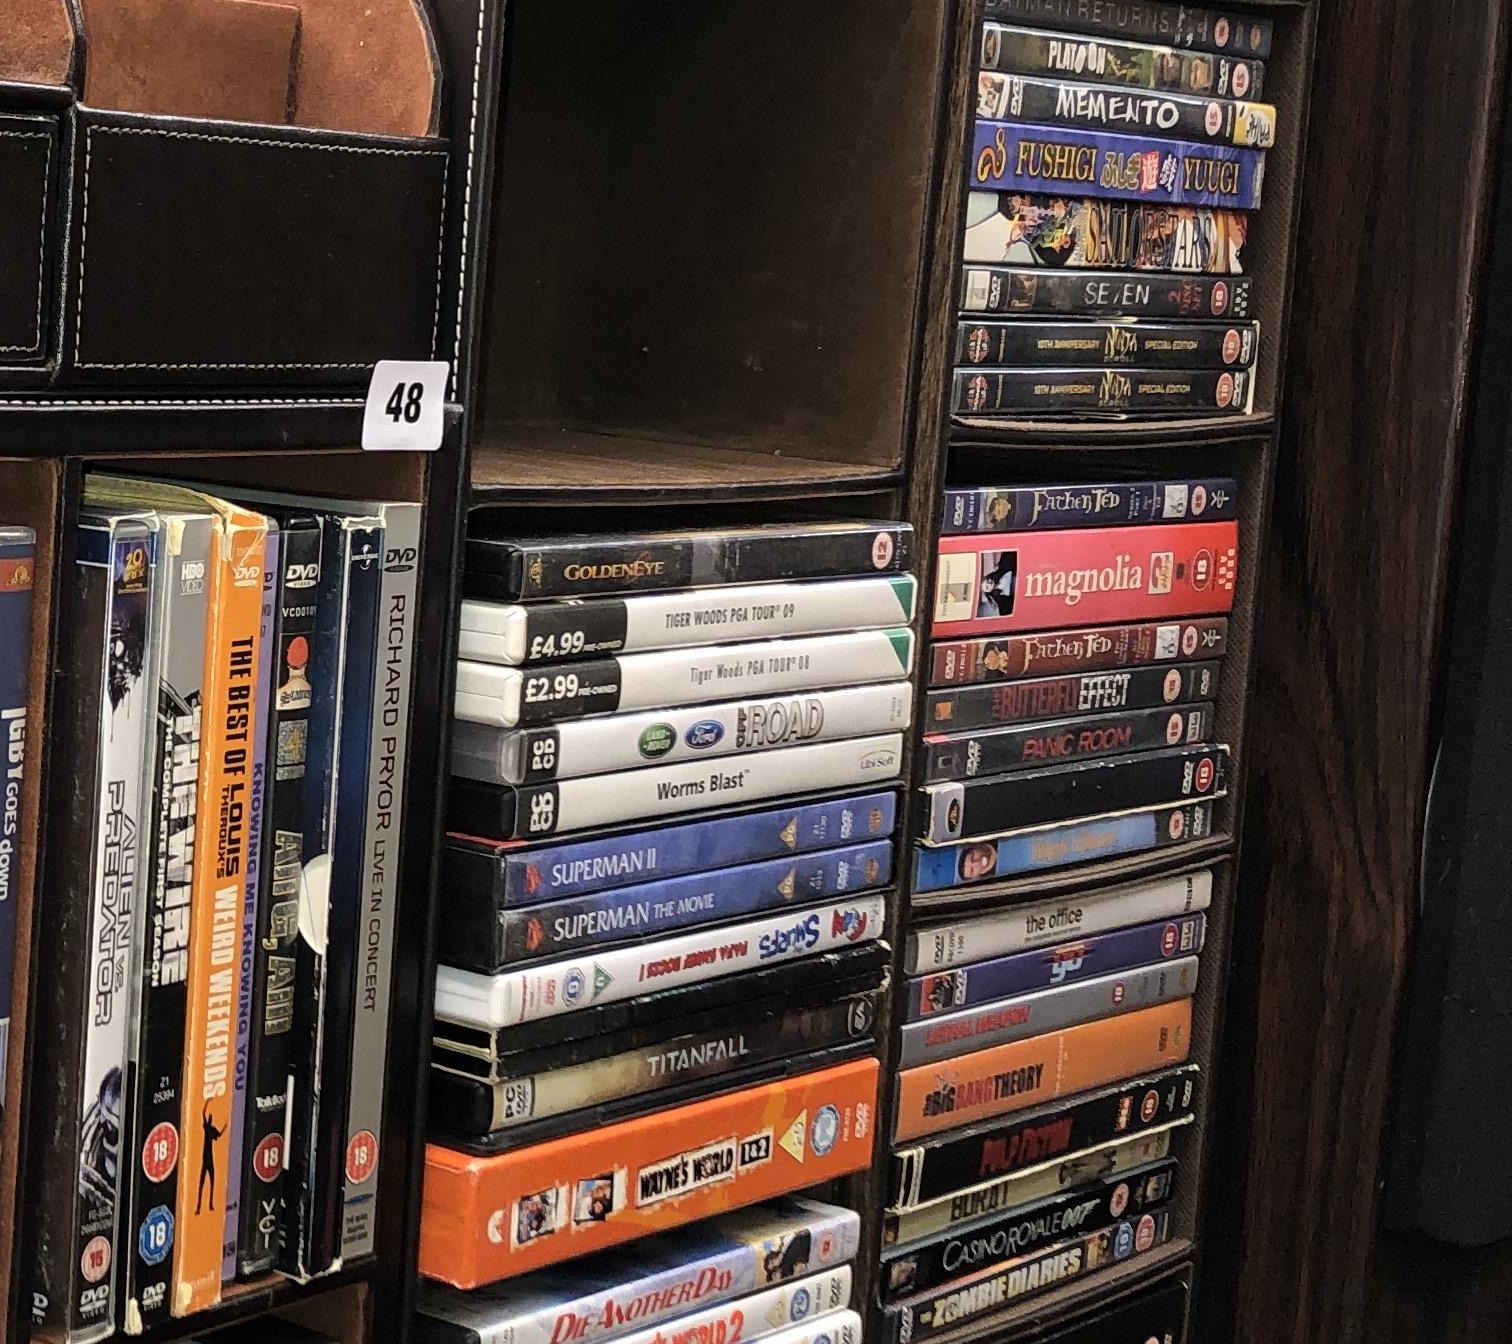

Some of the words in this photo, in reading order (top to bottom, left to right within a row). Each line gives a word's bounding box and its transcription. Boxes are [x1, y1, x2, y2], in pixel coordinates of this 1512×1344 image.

[1047, 40, 1107, 75] PLATOON
[1054, 83, 1180, 130] MEMENTO
[1015, 141, 1098, 182] FUSHIGI
[1183, 156, 1241, 194] YUUGI
[384, 382, 425, 425] 48
[1024, 553, 1143, 607] magnolia
[228, 635, 254, 678] THE
[381, 594, 407, 728] RICHARD
[529, 630, 585, 661] £4.99
[525, 674, 579, 703] £2.99
[1077, 673, 1132, 711] EFFECT
[224, 684, 252, 745] BEST
[749, 697, 825, 746] ROAD
[223, 749, 248, 777] OF
[532, 739, 545, 771] PC
[543, 737, 556, 769] CD
[1023, 732, 1076, 761] PANIC
[1079, 724, 1132, 752] ROOM
[375, 737, 398, 831] PRYOR
[224, 782, 245, 877] LOUIS
[372, 840, 387, 884] LIVE
[551, 851, 645, 886] SUPERMAN
[645, 847, 657, 870] II
[370, 889, 383, 912] IN
[553, 903, 650, 942] SUPERMAN
[653, 903, 675, 918] THE
[677, 892, 715, 912] MOVIE
[1025, 914, 1047, 934] the
[1048, 906, 1084, 929] office
[210, 884, 240, 967] WEIRD
[362, 918, 382, 1013] CONCERT
[202, 969, 235, 1100] WEEKENDS
[647, 1035, 751, 1076] TITANFALL
[993, 1063, 1045, 1100] THEORY
[152, 1139, 167, 1164] 18
[353, 1144, 369, 1167] 18
[638, 1161, 690, 1200] WAYNE'S
[693, 1147, 735, 1182] WORLD
[742, 1134, 772, 1166] 1&2
[598, 1282, 692, 1330] ANOTHER
[693, 1265, 736, 1294] DAY
[934, 1272, 1008, 1329] ZOMBIE
[1007, 1247, 1082, 1299] DIARIES
[730, 1309, 745, 1343] 2
